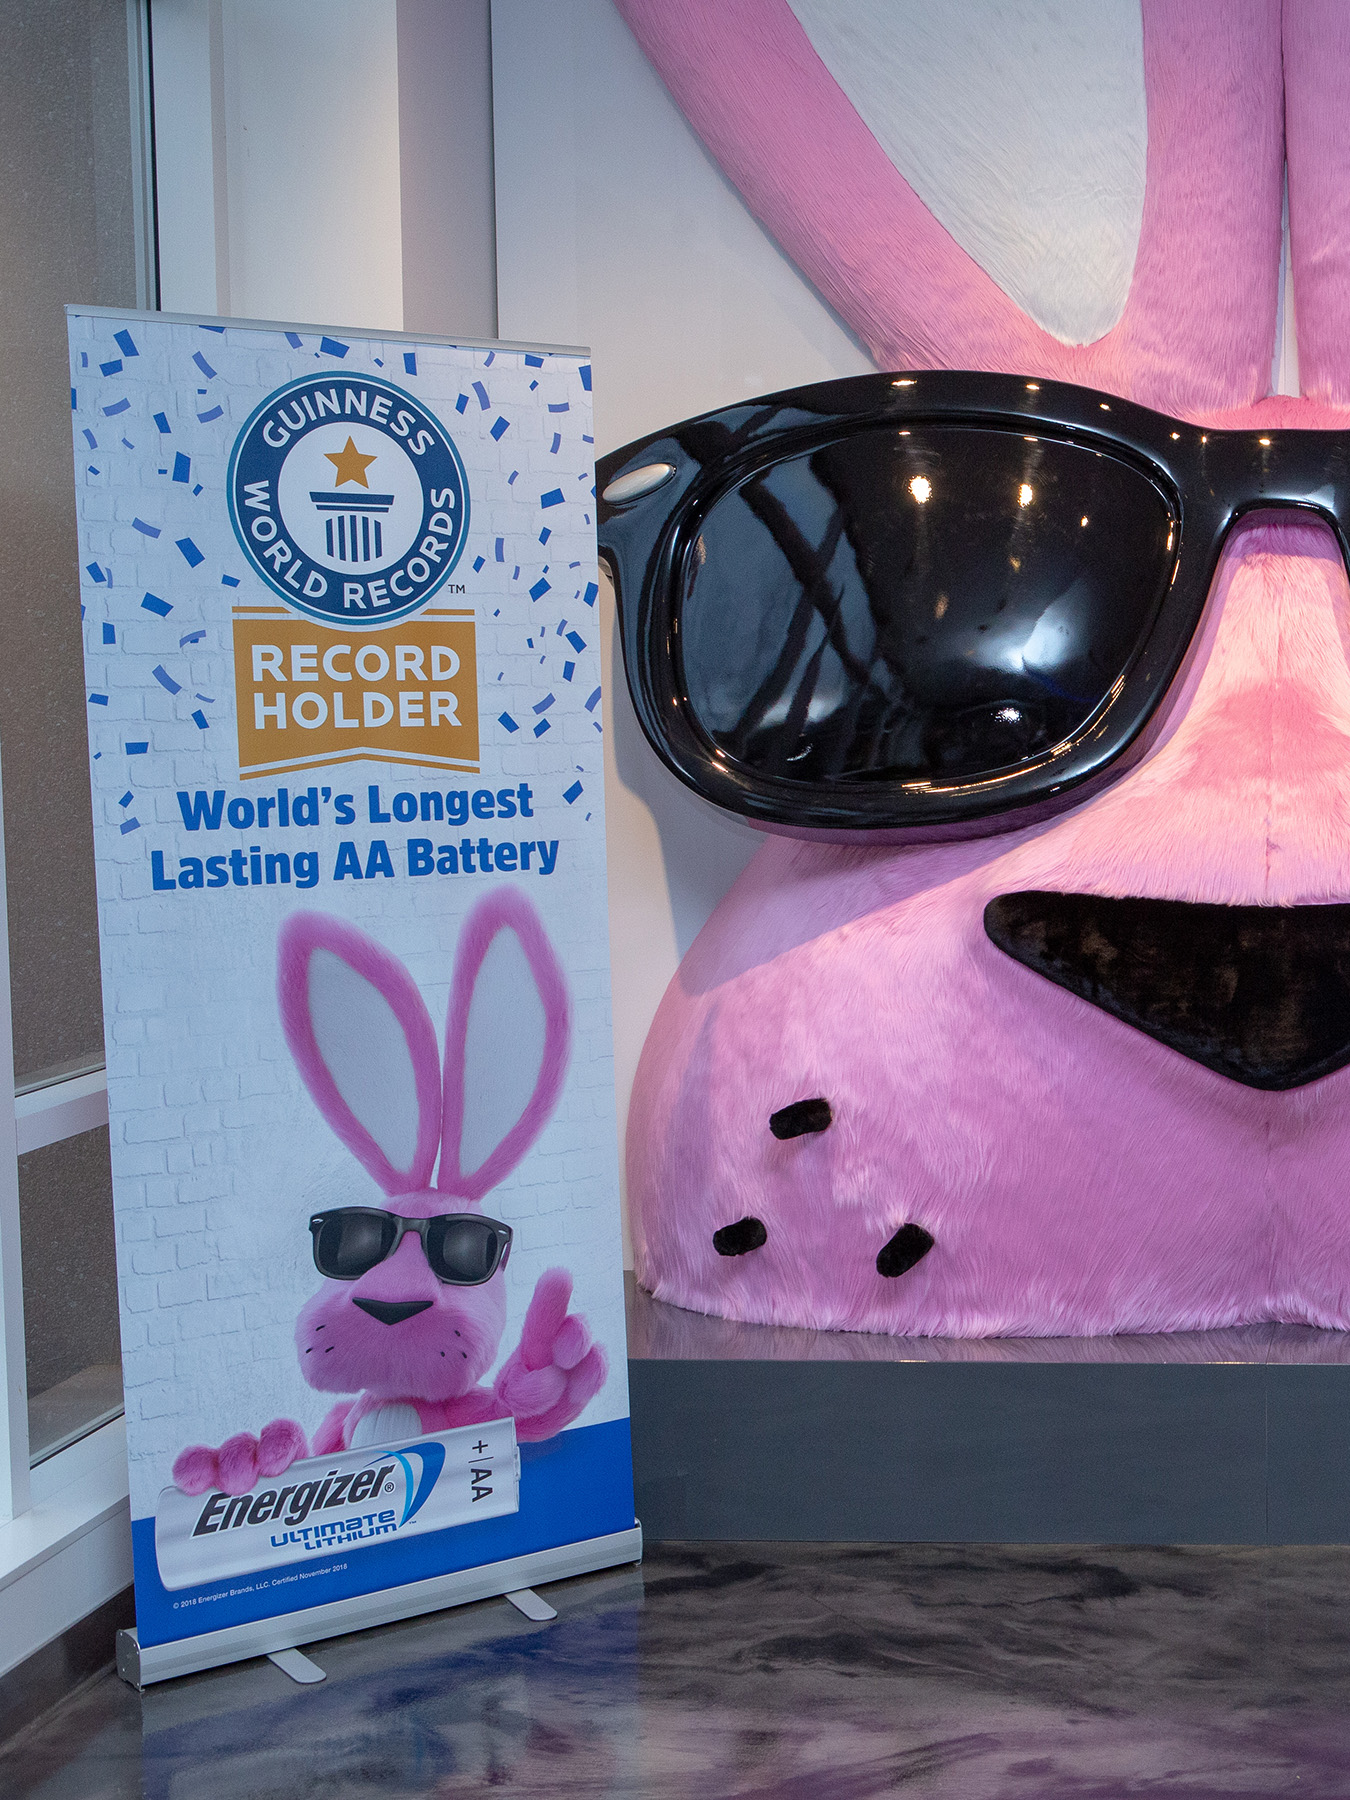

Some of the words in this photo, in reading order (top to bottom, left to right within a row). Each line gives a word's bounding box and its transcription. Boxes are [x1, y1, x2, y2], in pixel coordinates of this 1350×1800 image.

[262, 388, 435, 456] GUINNESS
[243, 479, 328, 598] WORLD
[343, 487, 455, 609] RECORDS
[251, 644, 461, 682] RECORD
[254, 692, 463, 730] HOLDER
[176, 786, 356, 831] World's
[368, 783, 534, 826] Longest
[151, 845, 320, 891] Lasting
[333, 841, 395, 882] AA
[408, 838, 560, 877] Battery
[180, 1598, 197, 1608] 2018
[198, 1590, 228, 1604] Energizer
[229, 1585, 255, 1597] Brands,
[271, 1574, 299, 1587] Certified
[299, 1567, 332, 1580] November
[332, 1563, 348, 1573] 2018
